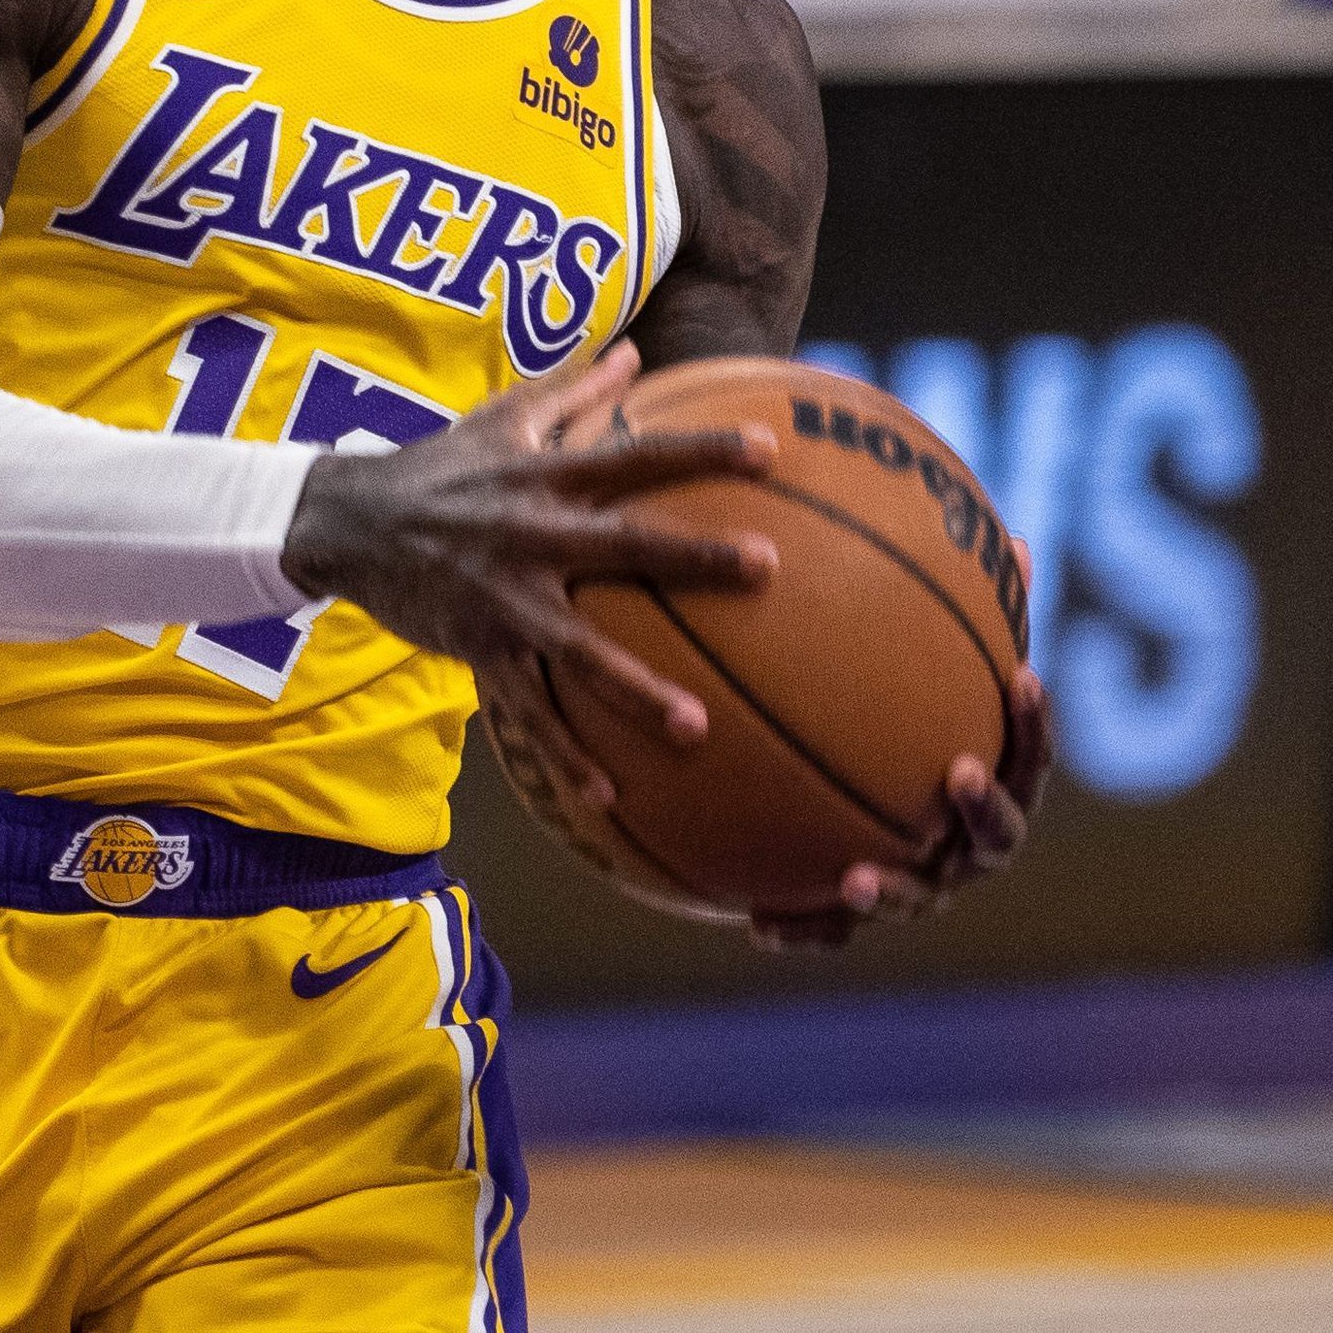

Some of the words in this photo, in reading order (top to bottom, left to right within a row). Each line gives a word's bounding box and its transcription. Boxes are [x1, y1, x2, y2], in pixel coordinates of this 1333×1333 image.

[519, 66, 616, 150] bibigo
[48, 44, 626, 381] LAKERS
[50, 834, 194, 889] LAKERS
